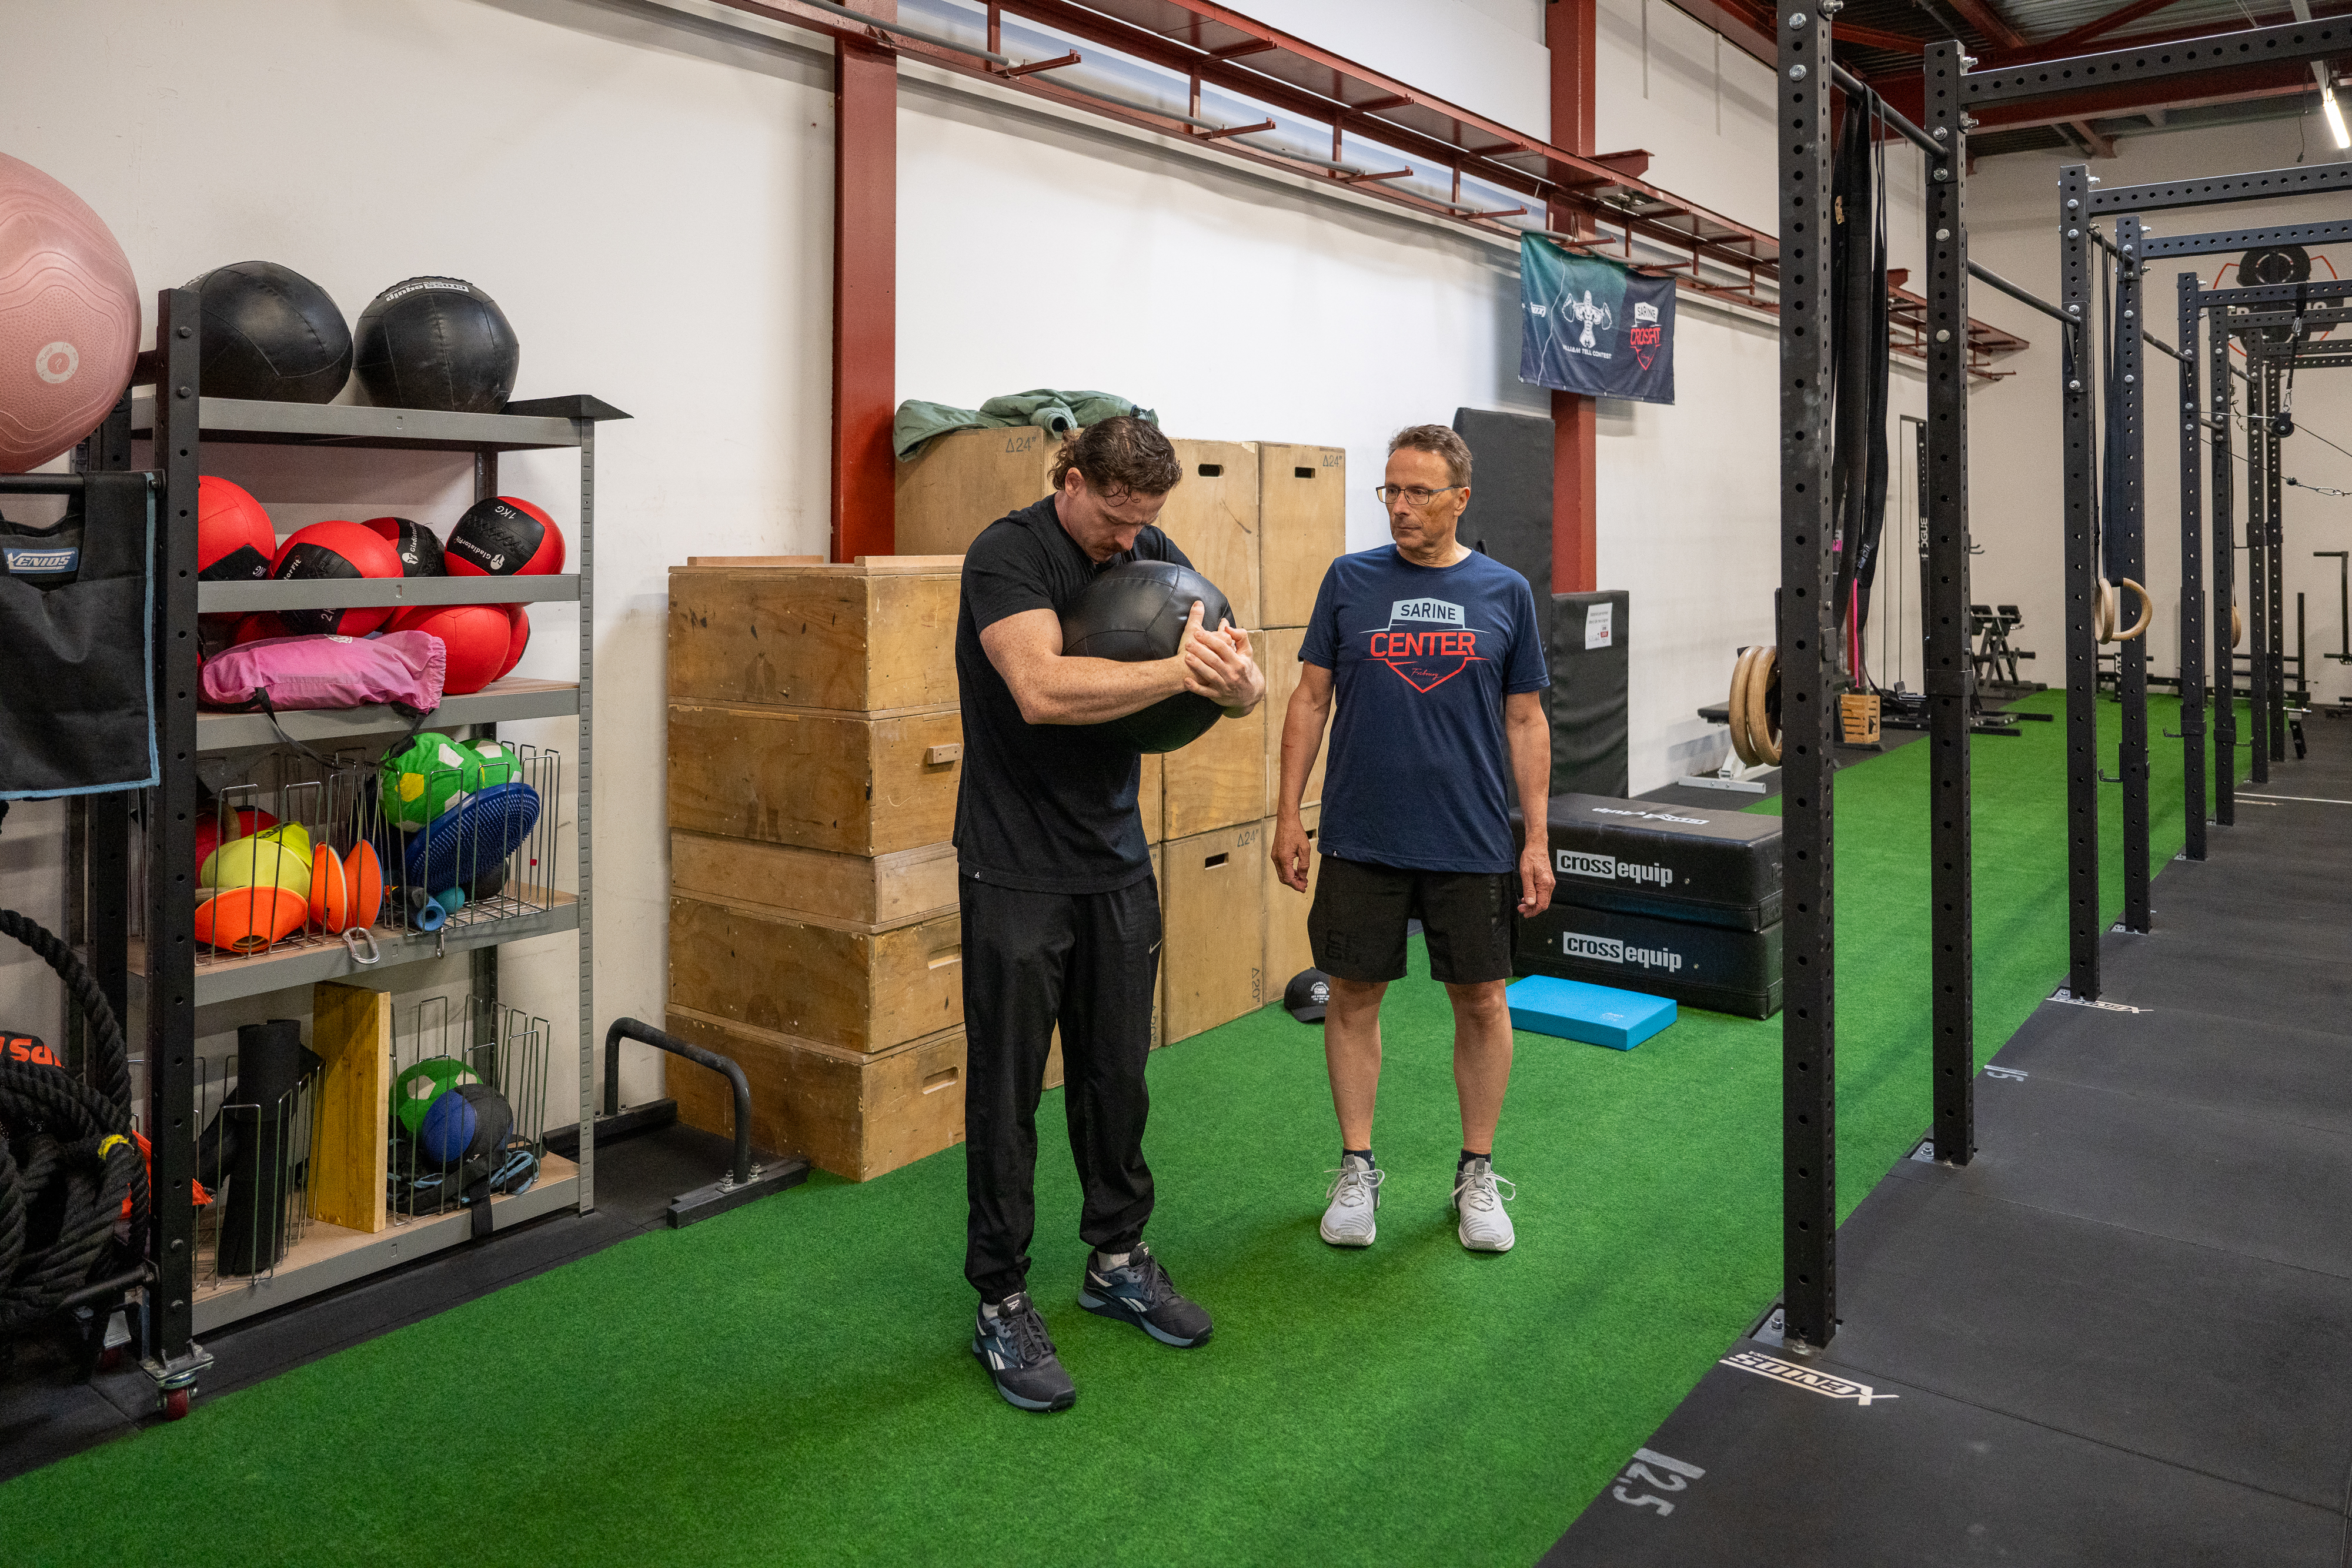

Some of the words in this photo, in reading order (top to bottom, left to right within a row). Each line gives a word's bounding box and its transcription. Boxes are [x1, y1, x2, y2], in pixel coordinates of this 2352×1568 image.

[1637, 306, 1656, 319] SARINE
[1592, 350, 1612, 359] CONTEST
[456, 536, 492, 559] GladiatorFit
[1400, 602, 1456, 620] SARINE
[1370, 631, 1476, 657] CENTER
[1411, 668, 1444, 681] Fribourg
[1560, 855, 1613, 875] cross
[1617, 862, 1673, 887] equip
[1567, 937, 1621, 958] cross
[1625, 947, 1682, 972] equip
[1007, 1299, 1020, 1307] Reebok
[995, 1336, 1005, 1353] Reebok
